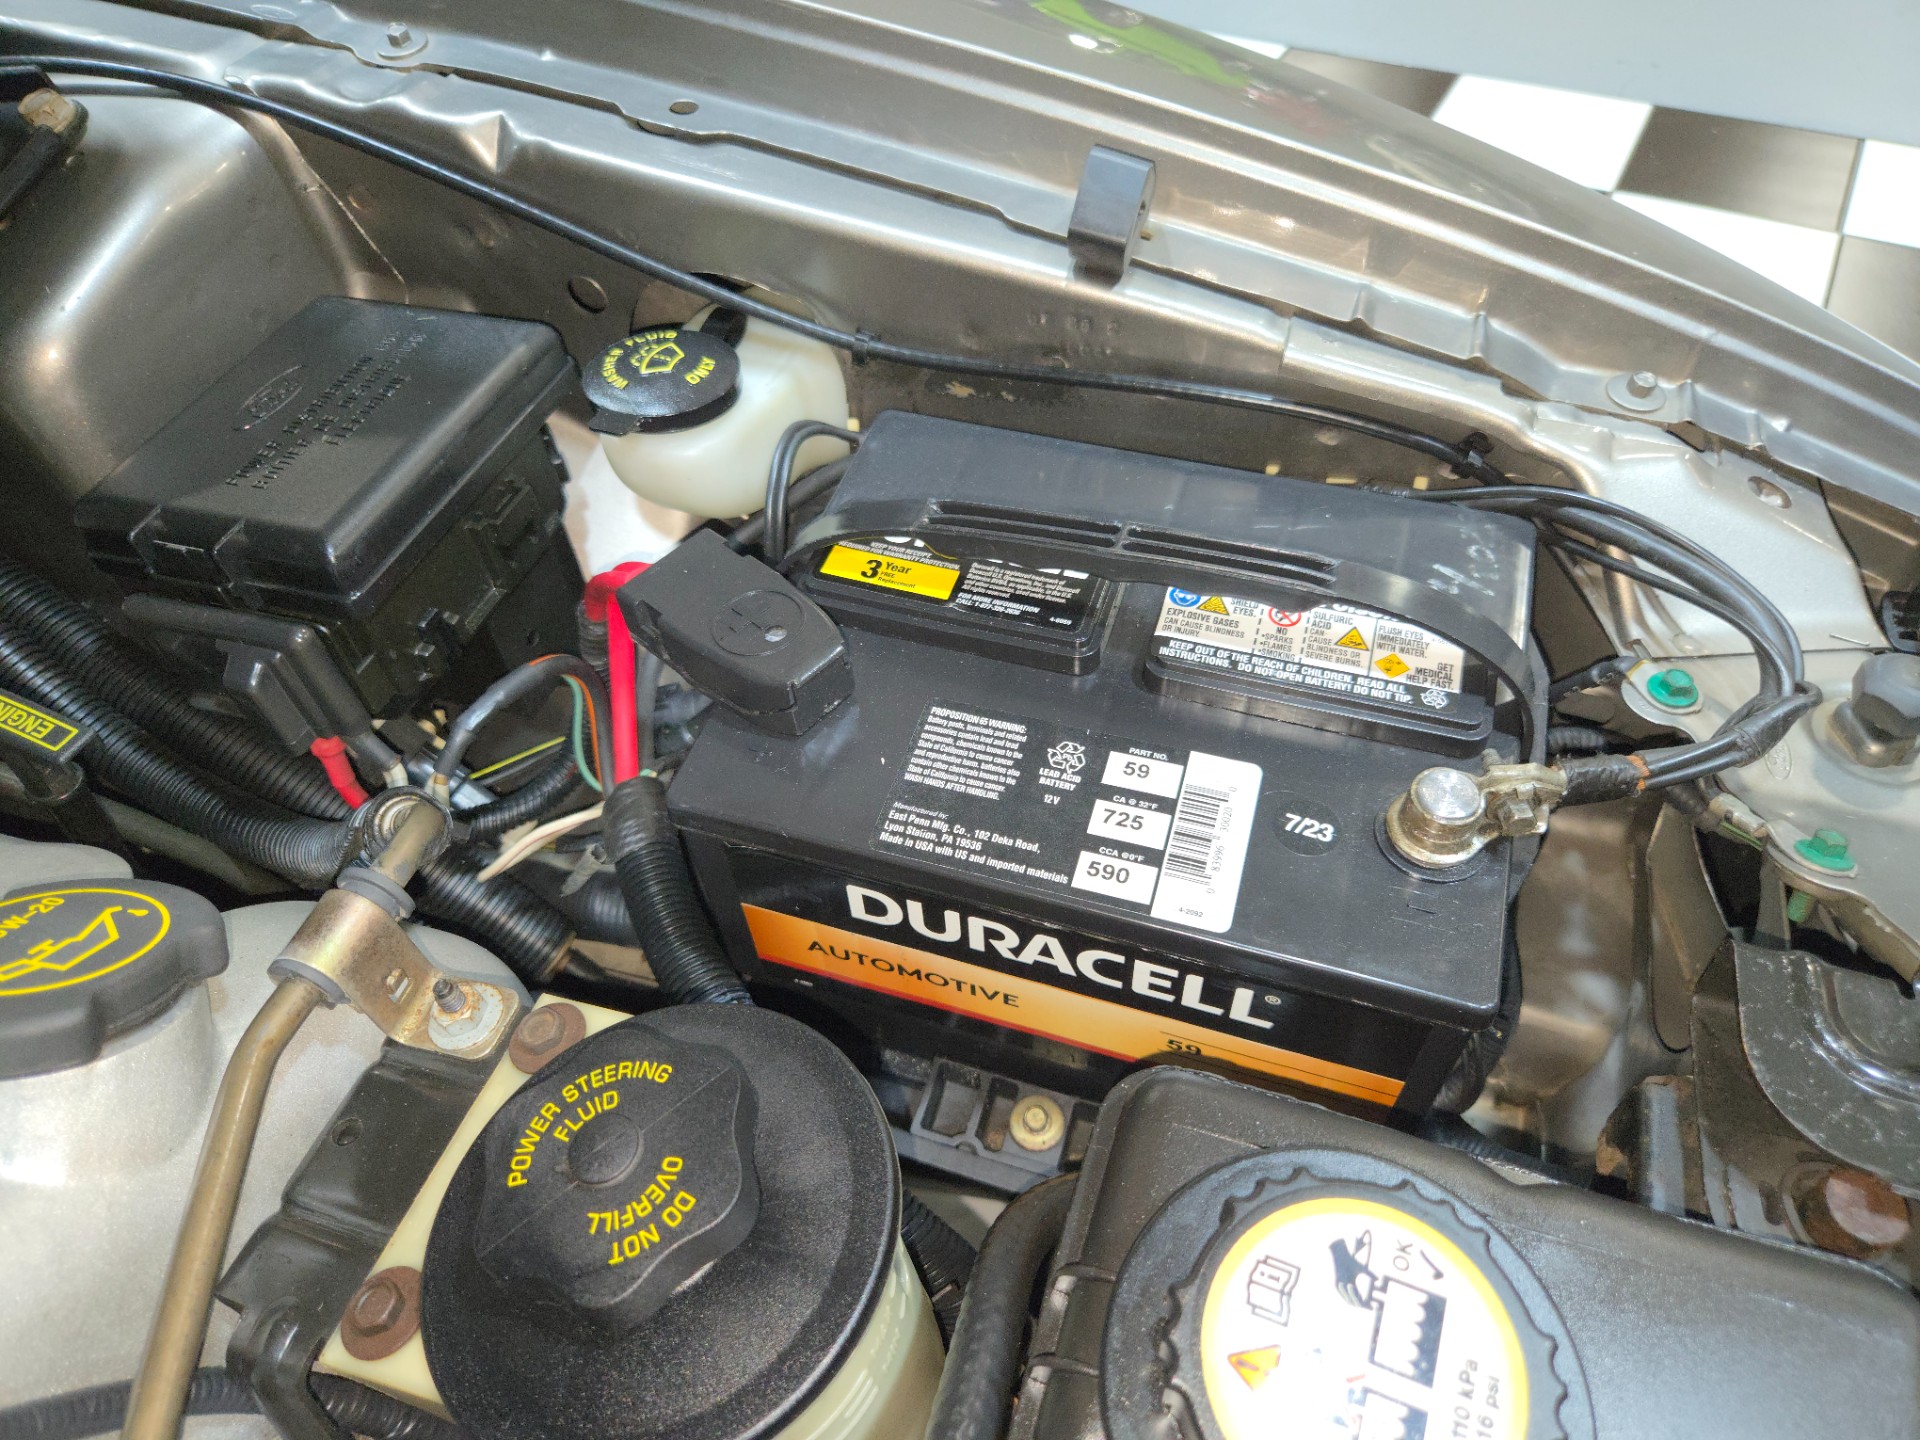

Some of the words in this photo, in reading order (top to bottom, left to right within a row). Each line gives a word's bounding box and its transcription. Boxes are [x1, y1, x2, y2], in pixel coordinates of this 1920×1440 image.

[601, 347, 628, 390] WASHER
[624, 330, 678, 346] FLUID
[684, 356, 716, 385] ONLY
[870, 541, 888, 551] KEEP
[887, 545, 905, 555] YOUR
[870, 546, 883, 555] FOR
[883, 548, 919, 562] WARRANTY
[861, 559, 882, 579] 3
[885, 561, 912, 575] Year
[880, 571, 896, 579] FREE
[877, 576, 916, 590] Replacement
[958, 592, 972, 600] FOR
[971, 595, 992, 604] MORE
[992, 599, 1041, 614] INFORMATION
[1231, 598, 1259, 609] SHIELD
[1233, 606, 1256, 618] EYES.
[1161, 624, 1172, 632] OR
[1164, 617, 1178, 627] CAN
[1180, 620, 1203, 631] CAUSE
[1205, 627, 1245, 639] BLINDNESS
[1167, 607, 1210, 623] EXPLOSIVE
[1212, 616, 1239, 629] GASES
[1311, 620, 1331, 630] ACID
[1313, 611, 1353, 625] SULFURIC
[1276, 627, 1289, 636] NO
[1308, 635, 1333, 646] CAUSE
[1377, 634, 1430, 649] IMMEDIATELY
[1379, 625, 1402, 636] FLUSH
[1404, 631, 1424, 641] EYES
[1305, 650, 1334, 663] SEVERE
[1335, 657, 1363, 668] BURNS.
[1306, 643, 1348, 657] BLINDNESS
[1350, 650, 1361, 659] OR
[1376, 642, 1396, 652] WITH
[1398, 646, 1427, 659] WATER.
[1159, 646, 1232, 669] INSTRUCTIONS.
[1237, 663, 1254, 673] DO
[1253, 666, 1275, 677] NOT
[1276, 669, 1303, 682] OPEN
[1304, 674, 1351, 692] BATTERY!
[1353, 685, 1370, 696] DO
[1370, 688, 1392, 700] NOT
[1393, 693, 1413, 705] TIP.
[1169, 640, 1193, 652] KEEP
[1195, 645, 1215, 656] OUT
[1217, 649, 1231, 658] OF
[1231, 651, 1250, 663] THE
[1251, 657, 1284, 670] REACH
[1285, 663, 1300, 672] OF
[1301, 666, 1354, 684] CHILDREN.
[1357, 677, 1385, 690] READ
[1386, 682, 1407, 694] ALL
[1415, 667, 1454, 682] MEDICAL
[1437, 662, 1455, 672] GET
[1406, 673, 1428, 685] HELP
[1430, 679, 1454, 691] FAST.
[927, 715, 949, 727] Battery
[966, 724, 994, 736] terminals
[994, 730, 1006, 738] and
[1005, 733, 1028, 742] related
[931, 706, 980, 724] PROPOSITION
[979, 717, 989, 726] 65
[988, 718, 1028, 734] WARNING:
[924, 724, 957, 736] accessories
[958, 731, 980, 741] contain
[979, 735, 994, 744] lead
[1005, 741, 1020, 750] lead
[1129, 747, 1152, 758] PART
[1153, 752, 1169, 761] NO.
[907, 764, 923, 775] State
[923, 768, 931, 776] of
[930, 769, 959, 782] California
[959, 775, 967, 783] to
[966, 779, 984, 788] cause
[911, 757, 933, 767] contain
[932, 761, 949, 771] other
[948, 764, 978, 777] chemicals
[979, 770, 999, 780] known
[1006, 776, 1017, 786] the
[1039, 767, 1060, 778] LEAD
[1061, 773, 1082, 784] ACID
[1123, 761, 1150, 779] 59
[904, 772, 924, 784] WASH
[923, 776, 946, 789] HANDS
[945, 781, 966, 793] AFTER
[965, 786, 1000, 801] HANDLING.
[1039, 776, 1076, 791] BATTERY
[893, 801, 938, 818] Manufactured
[1113, 795, 1126, 804] CA
[1103, 808, 1144, 831] 725
[1284, 812, 1336, 842] 7/23
[884, 820, 904, 833] Lyon
[906, 826, 938, 842] Station,
[941, 834, 953, 844] PA
[955, 837, 982, 851] 19536
[888, 810, 906, 821] East
[908, 814, 930, 827] Penn
[931, 820, 950, 833] Mfg.
[974, 829, 990, 841] 102
[991, 834, 1013, 846] Deka
[1015, 838, 1041, 854] Road,
[1211, 845, 1224, 872] 83996
[1220, 806, 1233, 832] 30020
[880, 832, 903, 844] Made
[904, 838, 913, 847] in
[915, 840, 933, 852] USA
[935, 845, 953, 857] with
[955, 849, 967, 860] US
[968, 853, 985, 864] and
[986, 857, 1025, 875] imported
[1027, 866, 1069, 884] materials
[1099, 847, 1119, 858] CCA
[1086, 861, 1130, 884] 590
[1178, 907, 1204, 918] 4-2092
[846, 884, 1275, 1029] DURACELL
[808, 940, 1020, 1008] AUTOMOTIVE
[1166, 1038, 1202, 1056] 59
[507, 1102, 561, 1188] POWER
[562, 1060, 673, 1102] STEERING
[553, 1090, 619, 1142] FLUID
[587, 1156, 684, 1235] OVERFILL
[662, 1191, 697, 1228] DO
[608, 1224, 660, 1265] NOT
[1392, 1240, 1413, 1271] OK
[1458, 1359, 1478, 1401] kPa
[1486, 1376, 1500, 1410] psi
